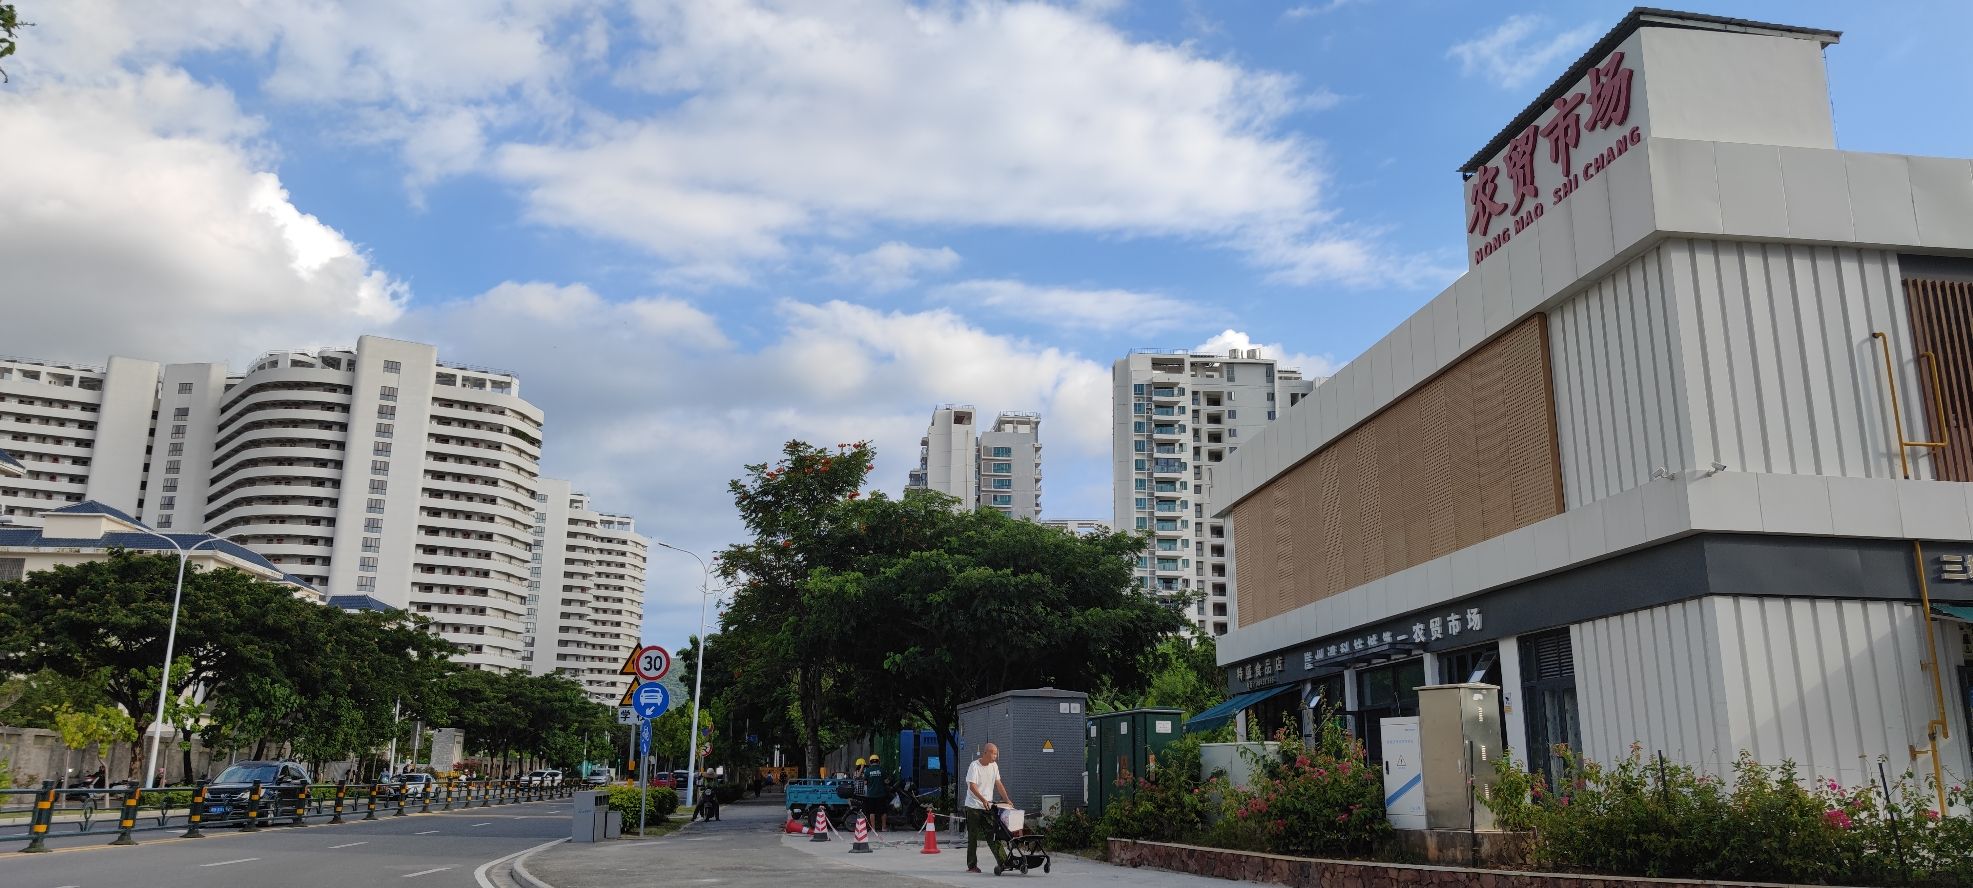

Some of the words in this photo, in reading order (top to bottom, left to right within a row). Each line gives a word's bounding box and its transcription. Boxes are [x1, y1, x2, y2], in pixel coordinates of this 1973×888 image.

[1468, 51, 1634, 237] 农贸市场
[1475, 227, 1511, 265] NONG
[1514, 202, 1544, 235] MAO
[1553, 174, 1579, 206] SHI
[1583, 126, 1641, 182] CHANG
[1940, 554, 1973, 581] 三
[643, 655, 663, 672] 30
